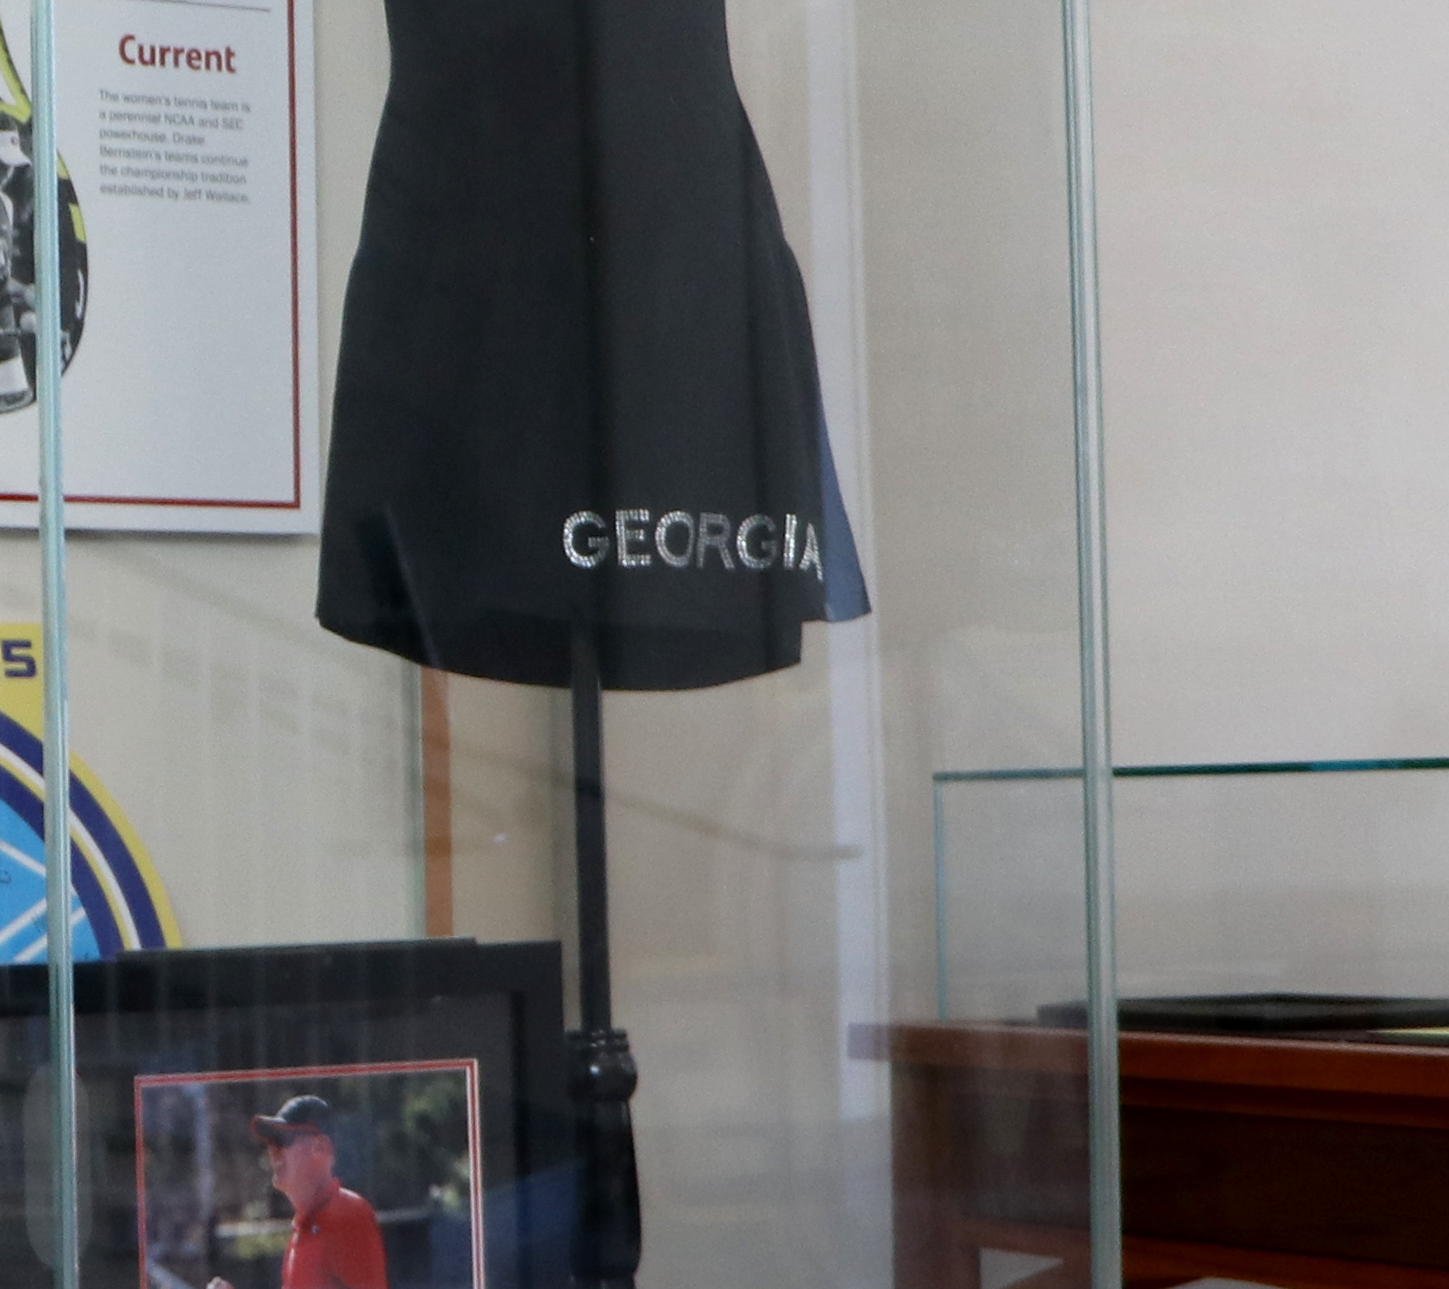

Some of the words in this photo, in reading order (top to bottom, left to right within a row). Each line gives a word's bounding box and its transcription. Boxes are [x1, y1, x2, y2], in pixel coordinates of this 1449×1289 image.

[118, 34, 237, 74] Current
[99, 88, 119, 102] The
[122, 92, 171, 107] women's
[174, 95, 208, 110] tennis
[210, 99, 239, 112] team
[241, 102, 251, 113] is
[109, 111, 161, 125] perennial
[164, 114, 195, 126] NCAA
[198, 117, 219, 129] and
[221, 118, 244, 130] SEC
[172, 132, 205, 146] Drake
[100, 144, 161, 161] Bernstein's
[164, 150, 198, 165] teams
[201, 154, 249, 167] continue
[100, 163, 118, 177] the
[121, 165, 199, 183] championship
[201, 171, 247, 185] tradition
[99, 183, 164, 199] established
[167, 186, 180, 201] by
[183, 188, 205, 202] Jeff
[562, 508, 824, 581] GEORGIA
